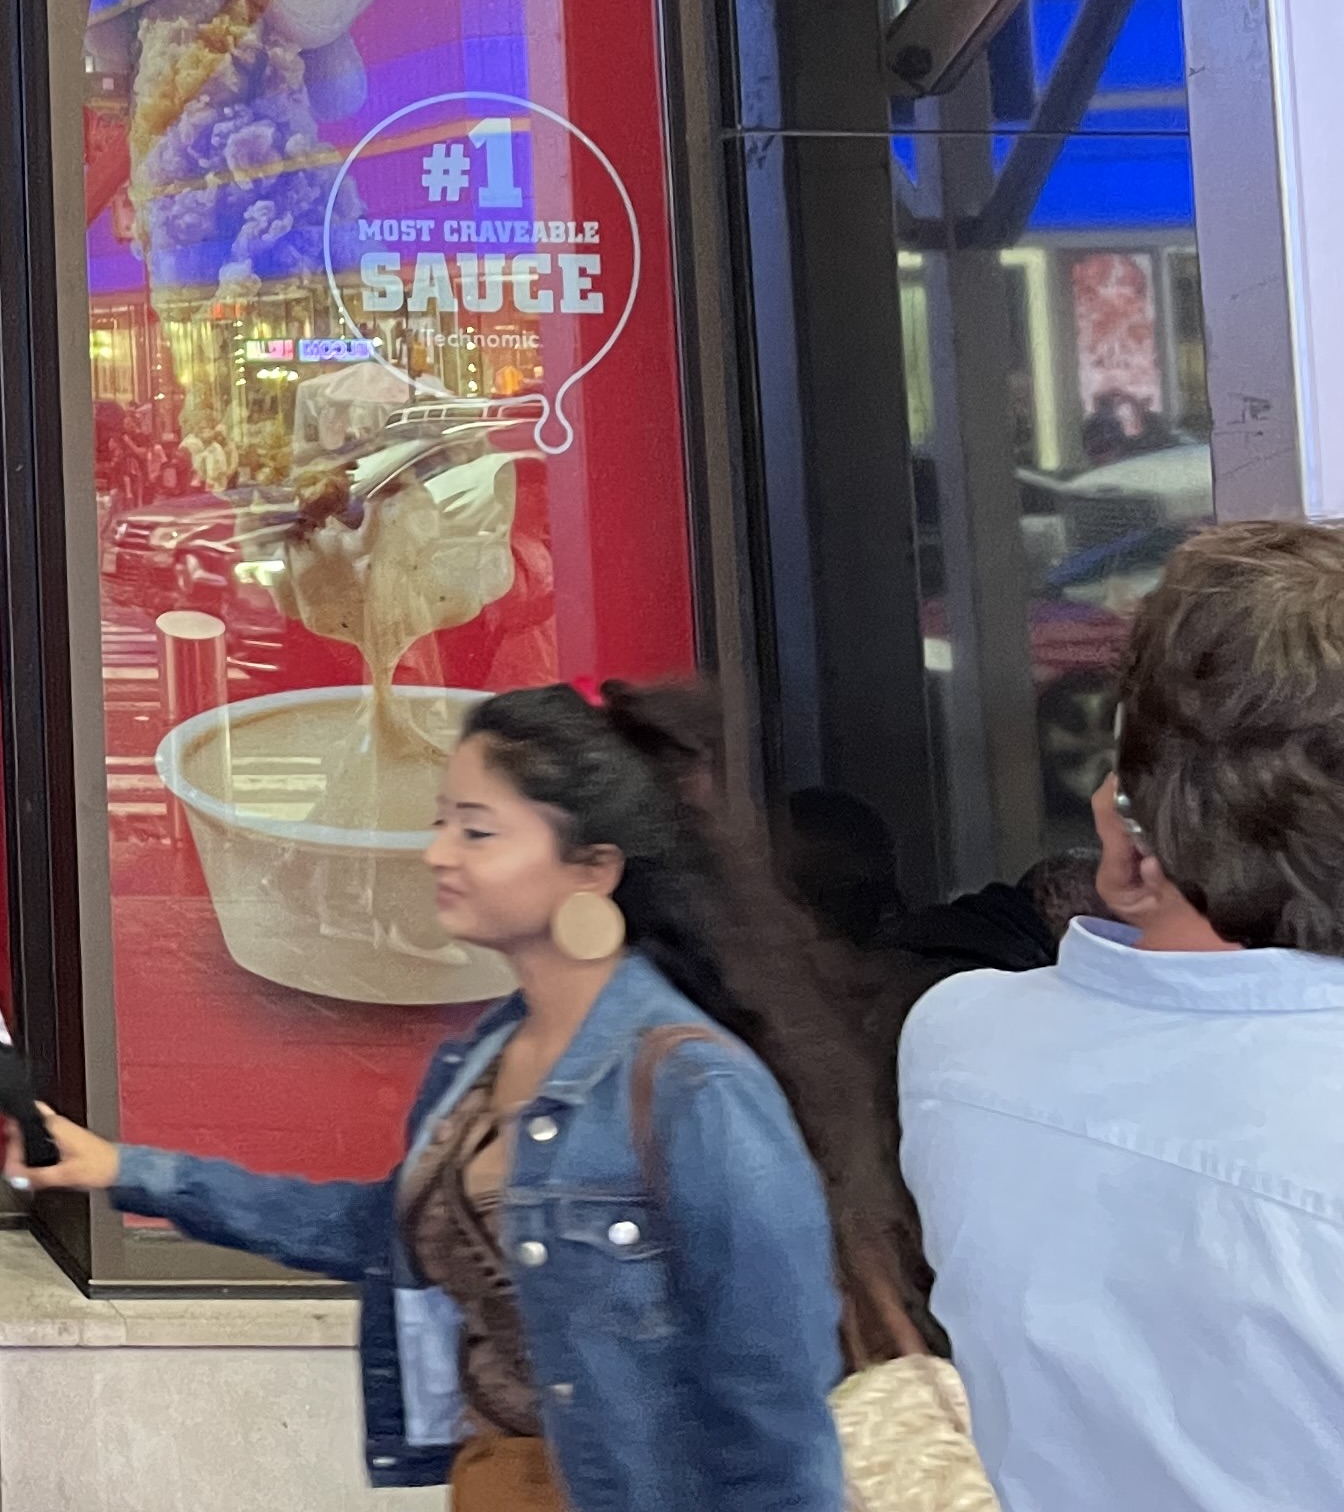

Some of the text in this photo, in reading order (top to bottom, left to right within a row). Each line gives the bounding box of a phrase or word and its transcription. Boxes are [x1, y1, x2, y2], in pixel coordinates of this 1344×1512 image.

[422, 117, 523, 209] #1
[358, 218, 601, 245] MOST CRAVEABLE
[358, 251, 605, 315] SAUCE
